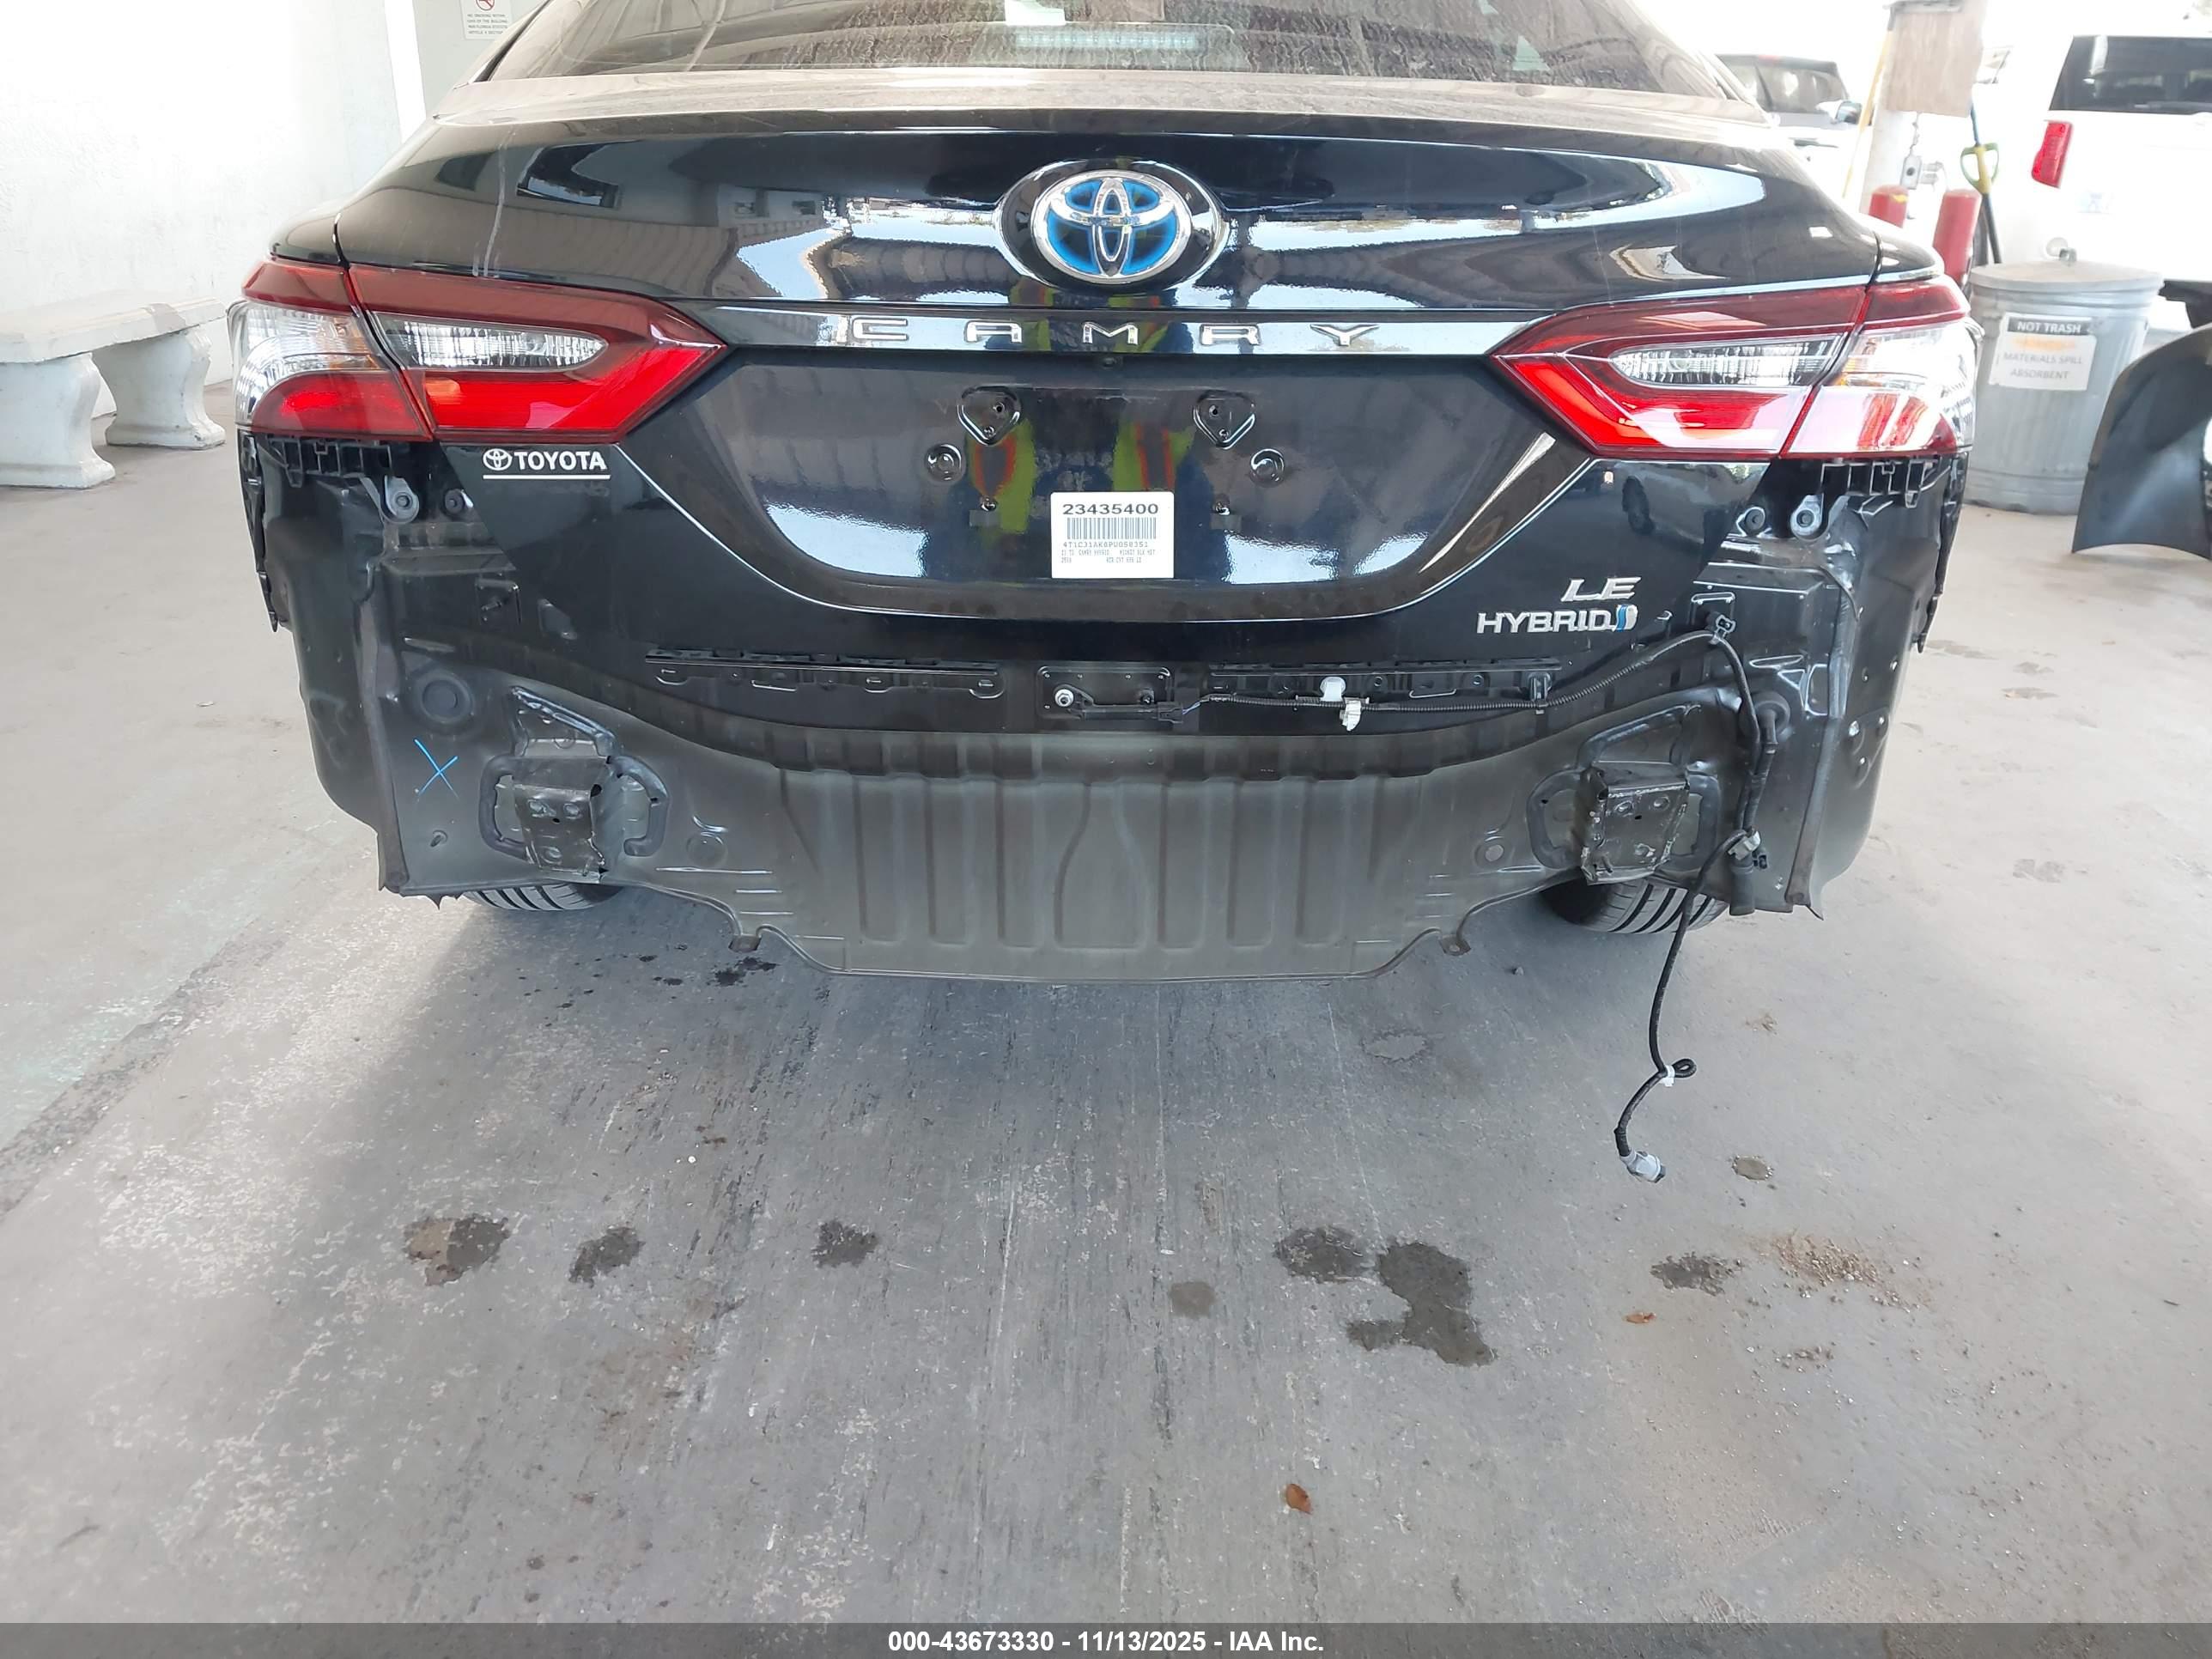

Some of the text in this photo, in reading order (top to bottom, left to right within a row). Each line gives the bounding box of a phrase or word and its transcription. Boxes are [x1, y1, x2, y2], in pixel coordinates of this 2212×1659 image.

[853, 318, 1380, 346] CAMRY
[2017, 321, 2081, 334] NOT TRASH
[2003, 352, 2056, 365] MATERIALS
[2010, 368, 2070, 380] ABSORBENT
[514, 451, 608, 471] TOYOTA
[1062, 503, 1159, 515] 23435400
[1560, 576, 1642, 602] LE
[1476, 610, 1616, 634] HYBRID
